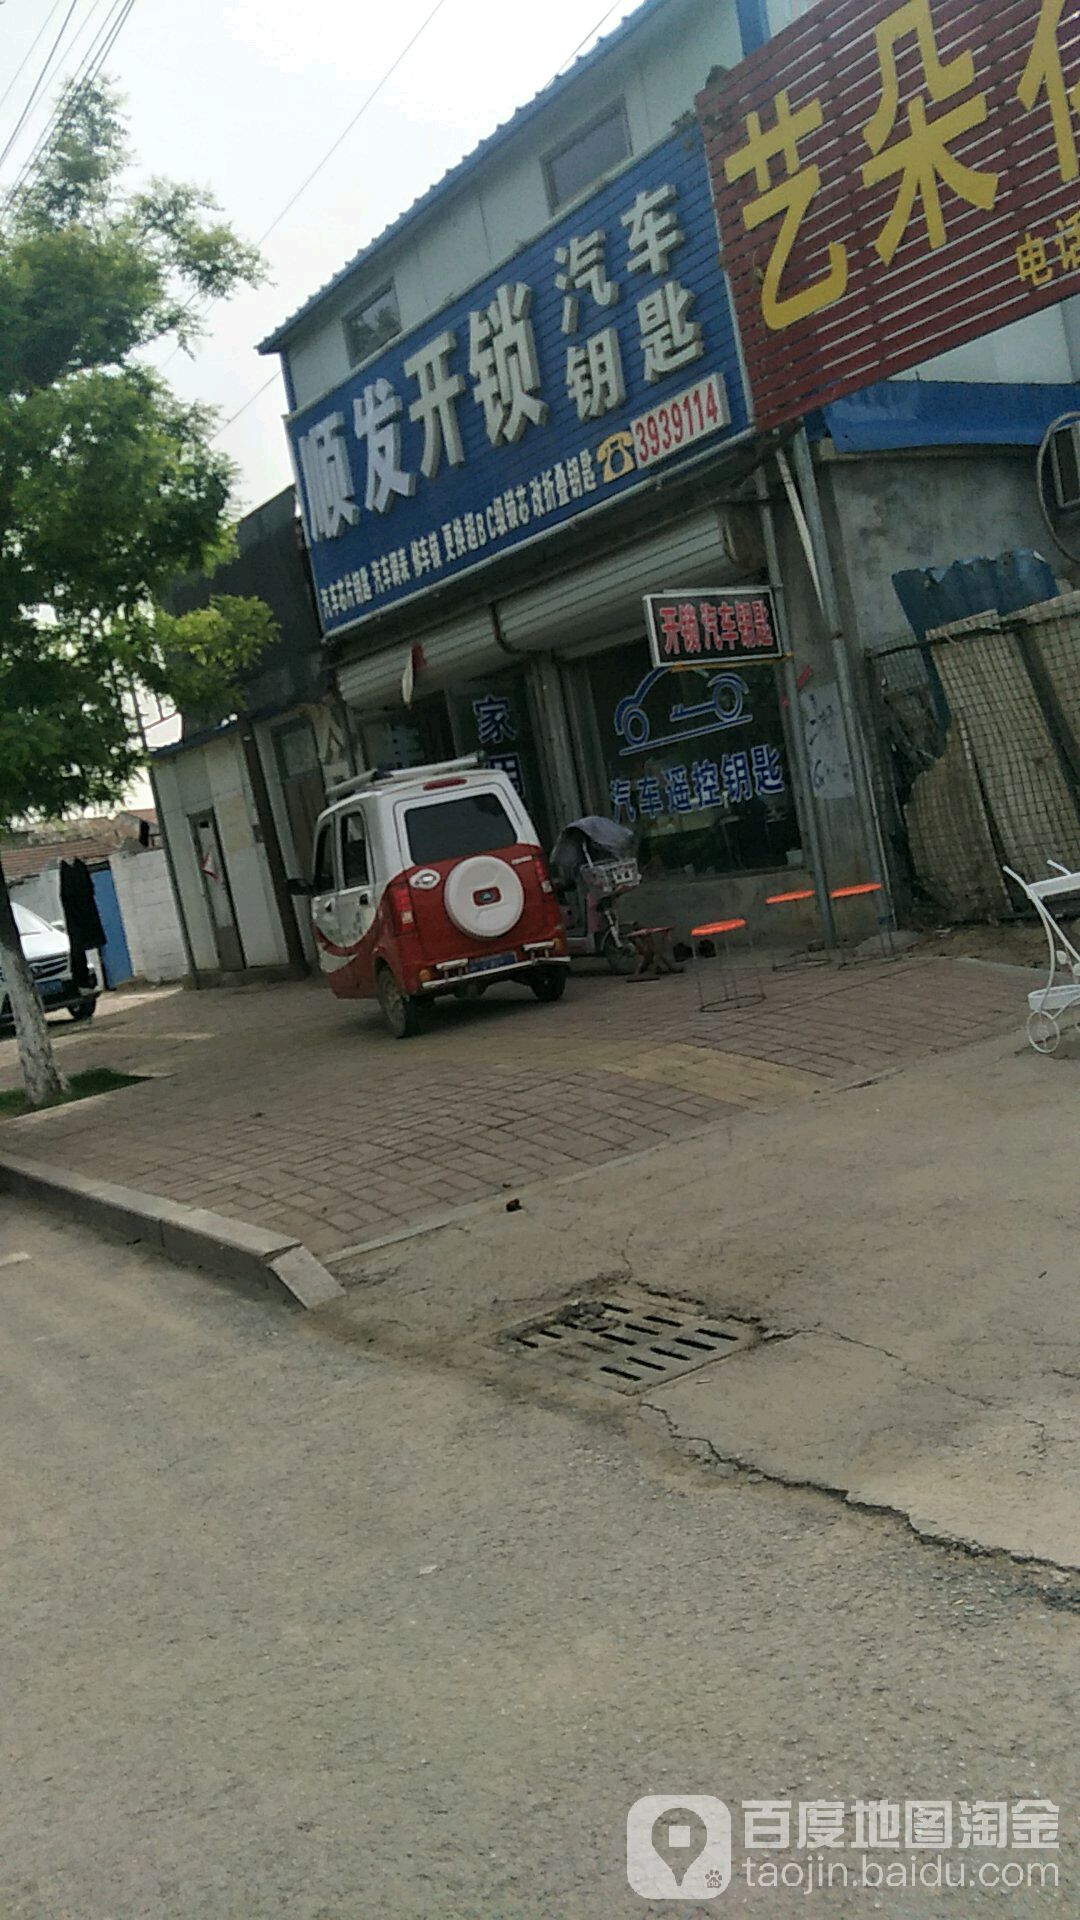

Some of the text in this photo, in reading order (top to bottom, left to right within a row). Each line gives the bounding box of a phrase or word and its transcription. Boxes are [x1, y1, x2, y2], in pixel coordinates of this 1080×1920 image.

[554, 183, 685, 335] 汽车
[1016, 211, 1080, 286] 电话
[566, 280, 705, 422] 钥匙
[298, 281, 550, 543] 顺发开锁
[635, 382, 717, 462] 3939114
[609, 744, 785, 823] 汽车遥控钥匙
